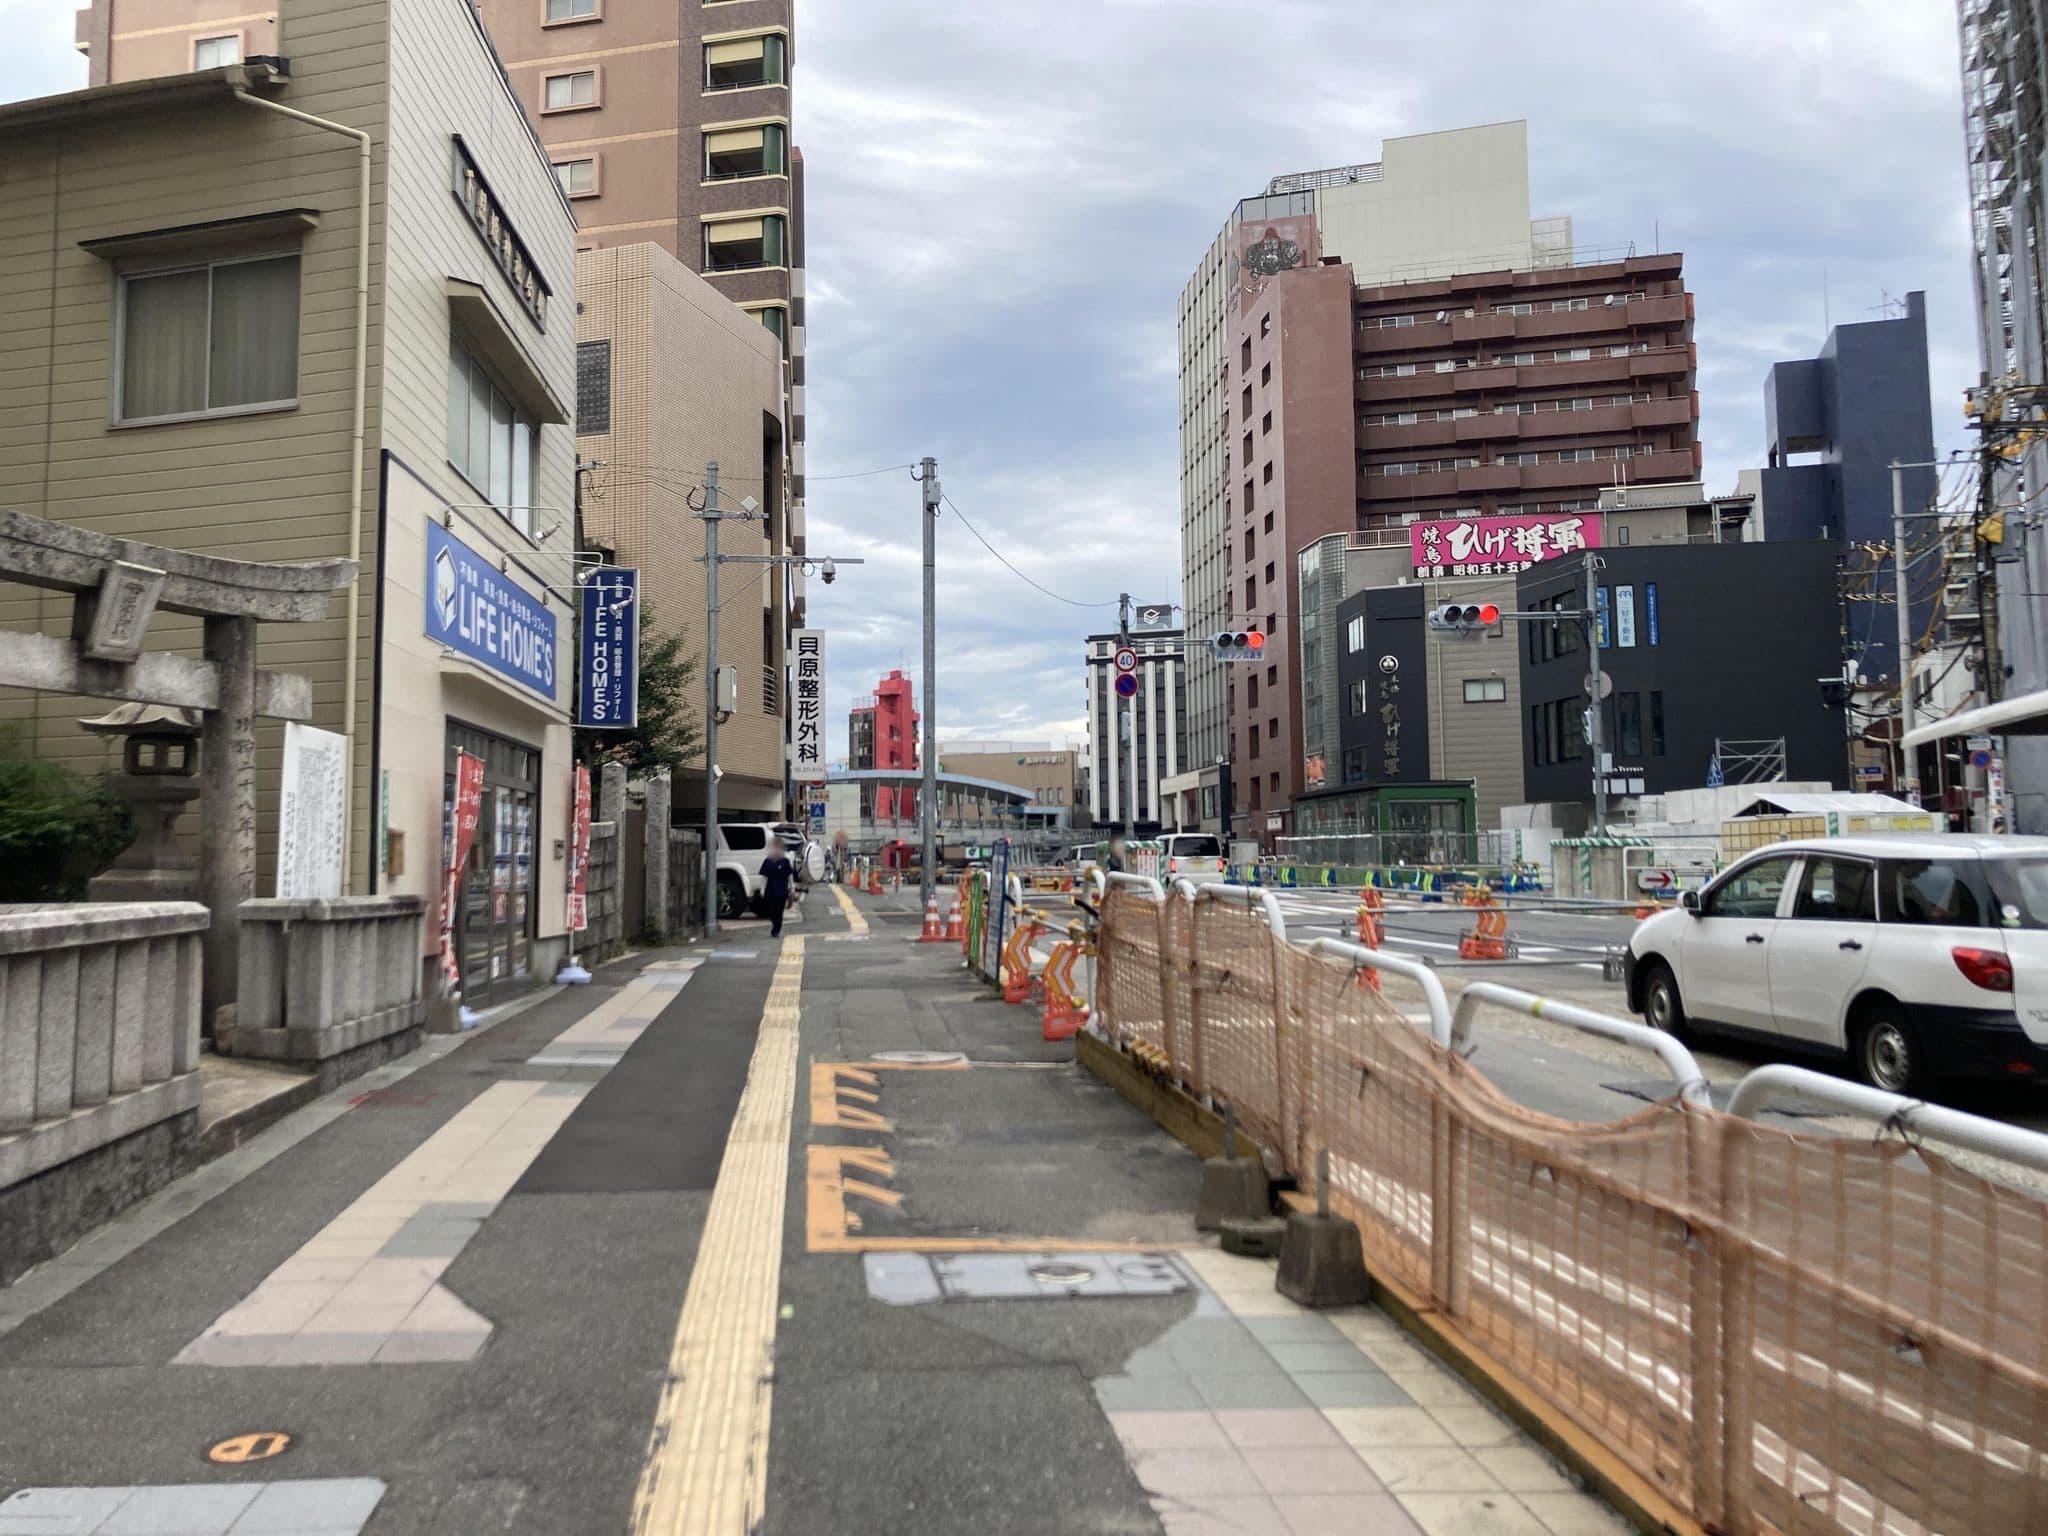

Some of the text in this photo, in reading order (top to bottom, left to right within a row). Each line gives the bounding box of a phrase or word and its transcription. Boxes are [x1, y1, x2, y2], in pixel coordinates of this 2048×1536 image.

[1421, 525, 1443, 564] 焼鳥
[1447, 519, 1585, 562] ひげ将軍
[458, 583, 553, 686] LIFE HOME'S
[591, 575, 610, 721] LIFE HOME'S
[1119, 655, 1133, 666] 40
[798, 637, 819, 763] 貝原整形外科
